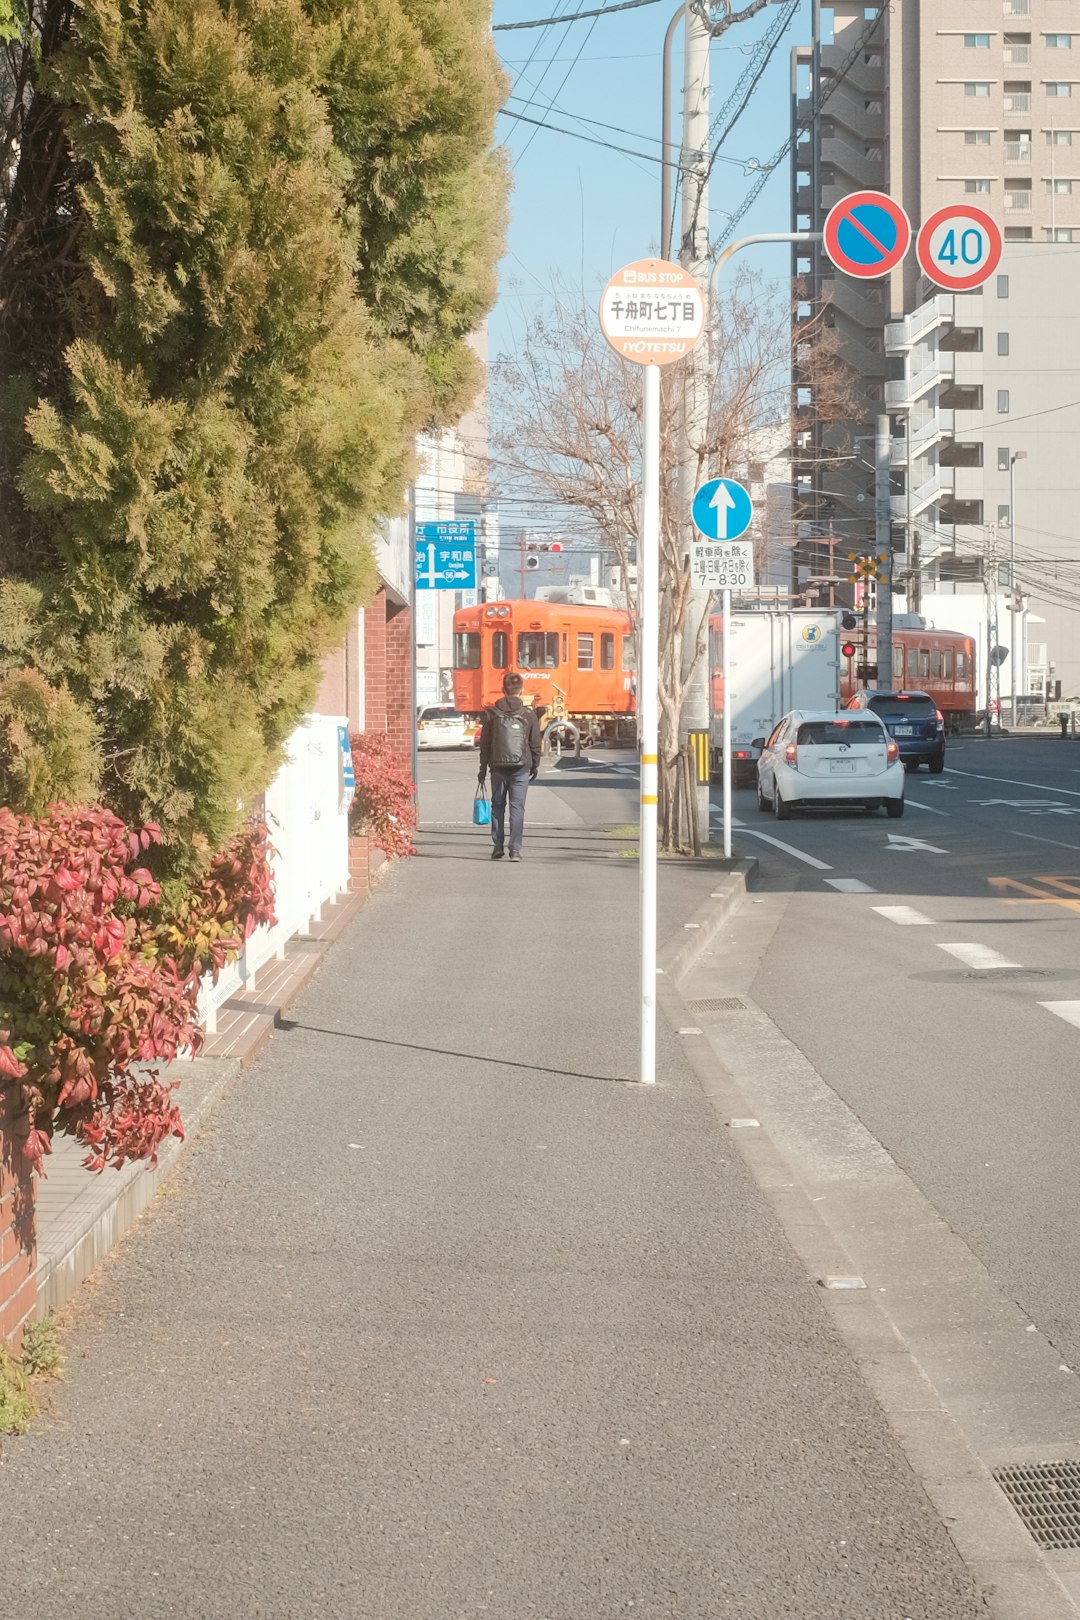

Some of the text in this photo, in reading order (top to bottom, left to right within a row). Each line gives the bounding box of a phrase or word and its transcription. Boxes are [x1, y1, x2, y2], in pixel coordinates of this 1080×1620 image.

[937, 228, 983, 265] 40
[637, 271, 684, 283] BUS STOP
[610, 300, 695, 321] 千舟町七丁目
[624, 324, 675, 333] Chifunemachi
[623, 340, 686, 353] IYOTETSU
[436, 523, 470, 535] 市役所
[439, 550, 473, 562] 宇和島
[695, 545, 748, 557] 軽車両を除く
[489, 566, 496, 574] P
